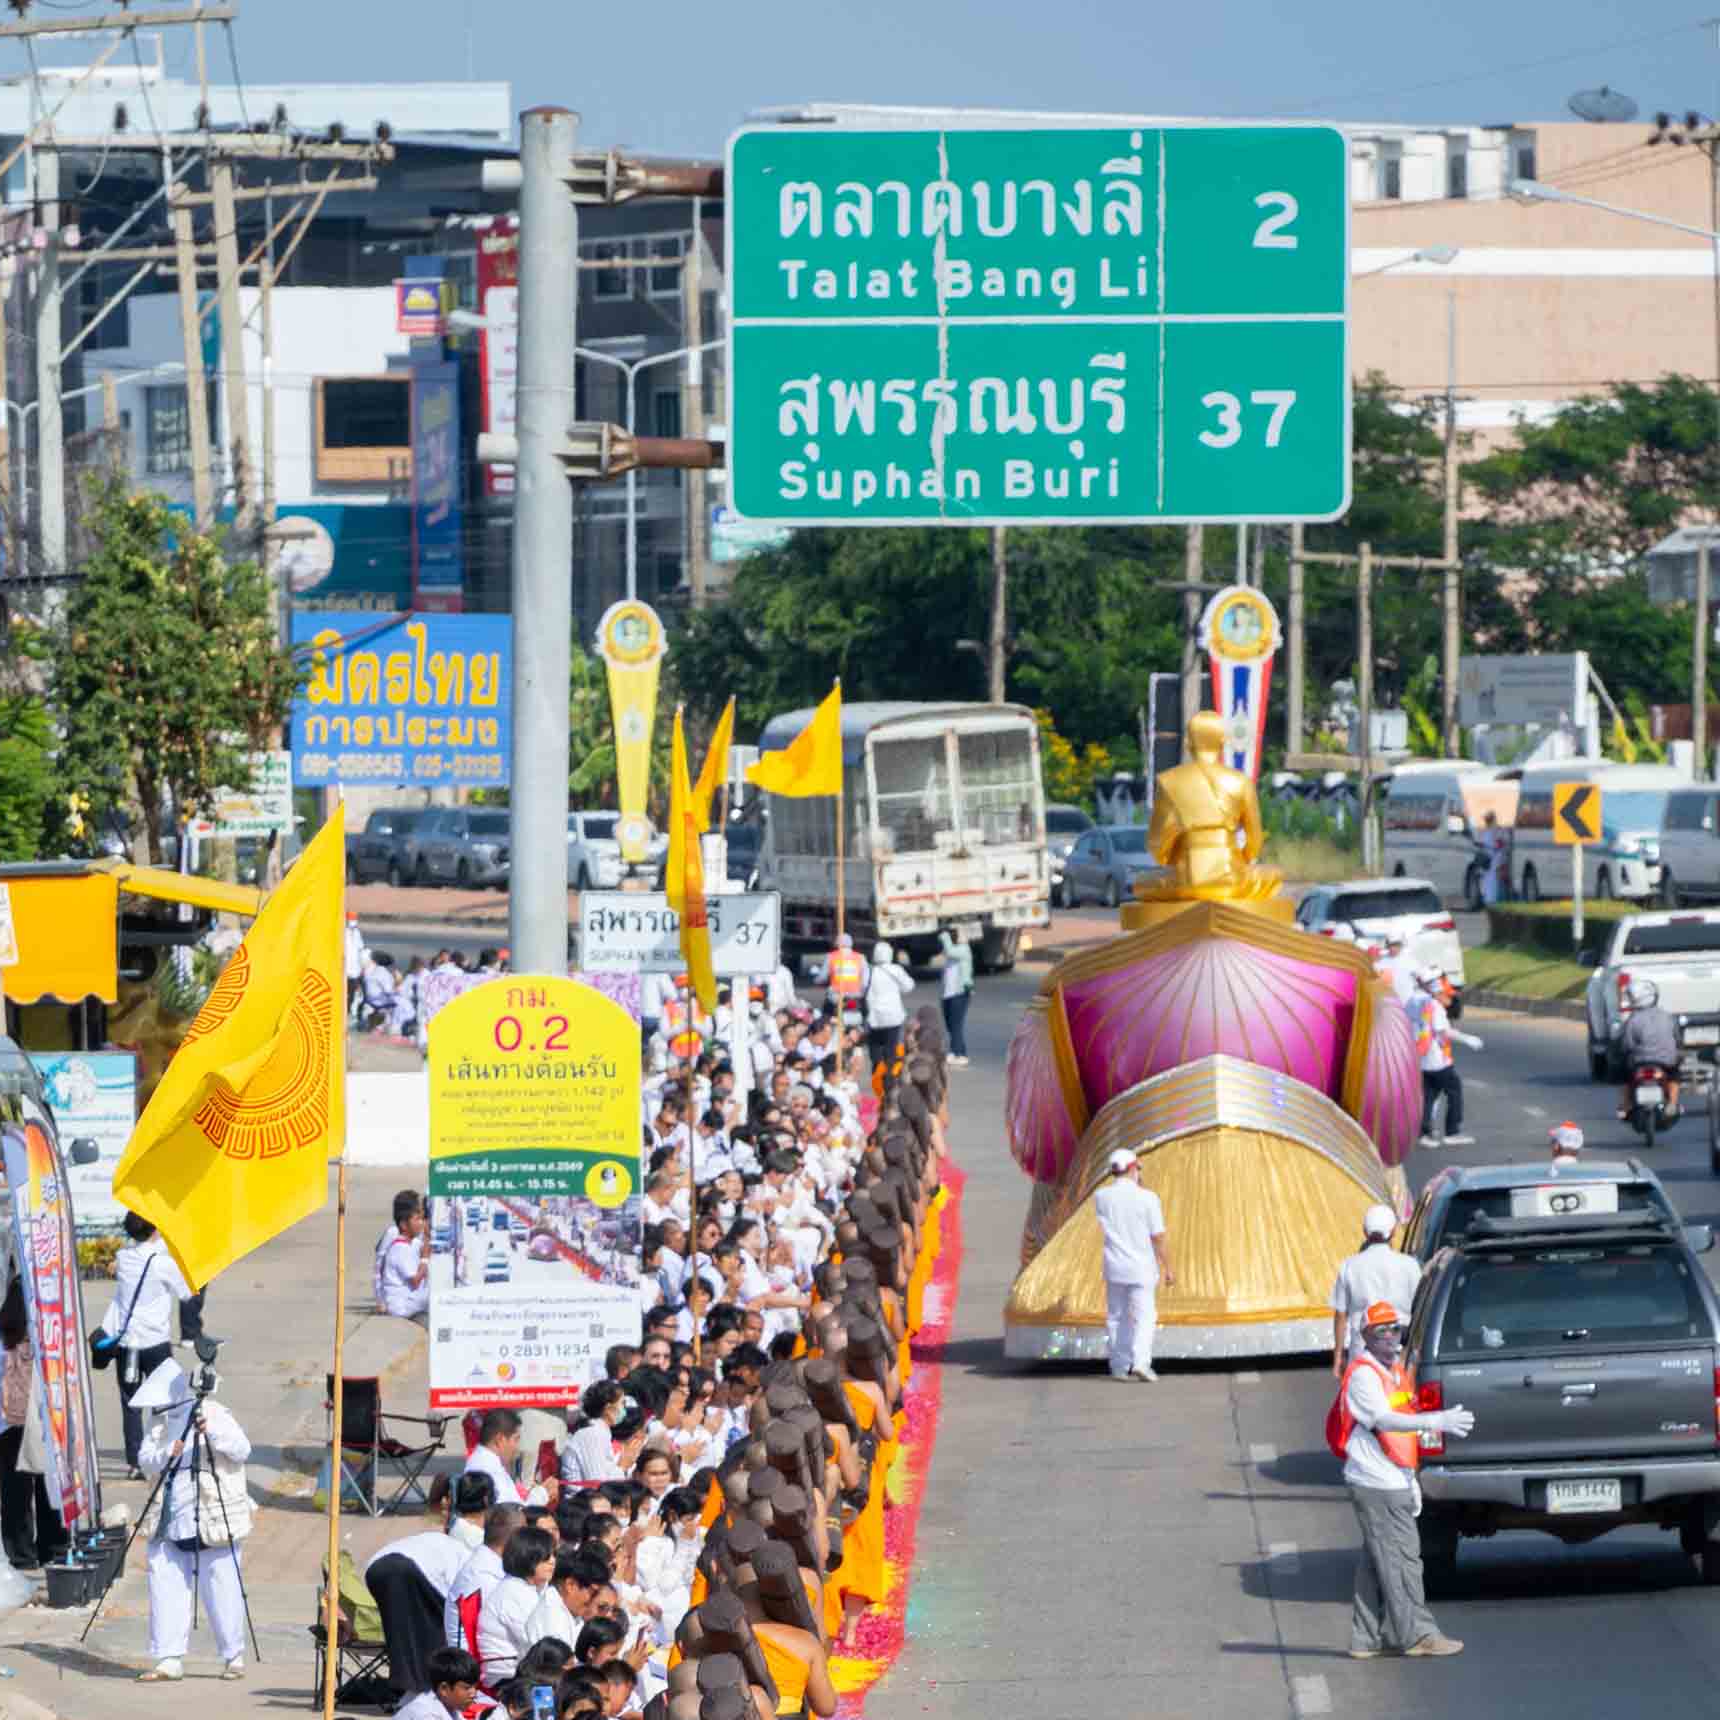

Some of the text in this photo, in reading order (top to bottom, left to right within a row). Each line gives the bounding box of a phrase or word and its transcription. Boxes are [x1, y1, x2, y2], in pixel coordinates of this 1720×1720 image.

[779, 131, 1144, 237] ตลาดบางลี่
[1252, 191, 1299, 248] 2
[779, 256, 1149, 309] Talat Bang Li
[778, 351, 1128, 459] สุพรรณบุรี
[1198, 390, 1297, 449] 37
[779, 459, 1120, 507] Suphan Buri
[306, 620, 501, 706] มิตรไทย
[304, 710, 499, 747] การประมง
[735, 922, 769, 945] 37
[506, 986, 558, 1008] กม.
[494, 1015, 569, 1052] 0.2
[447, 1054, 617, 1081] เส้นทางต้อนรับ
